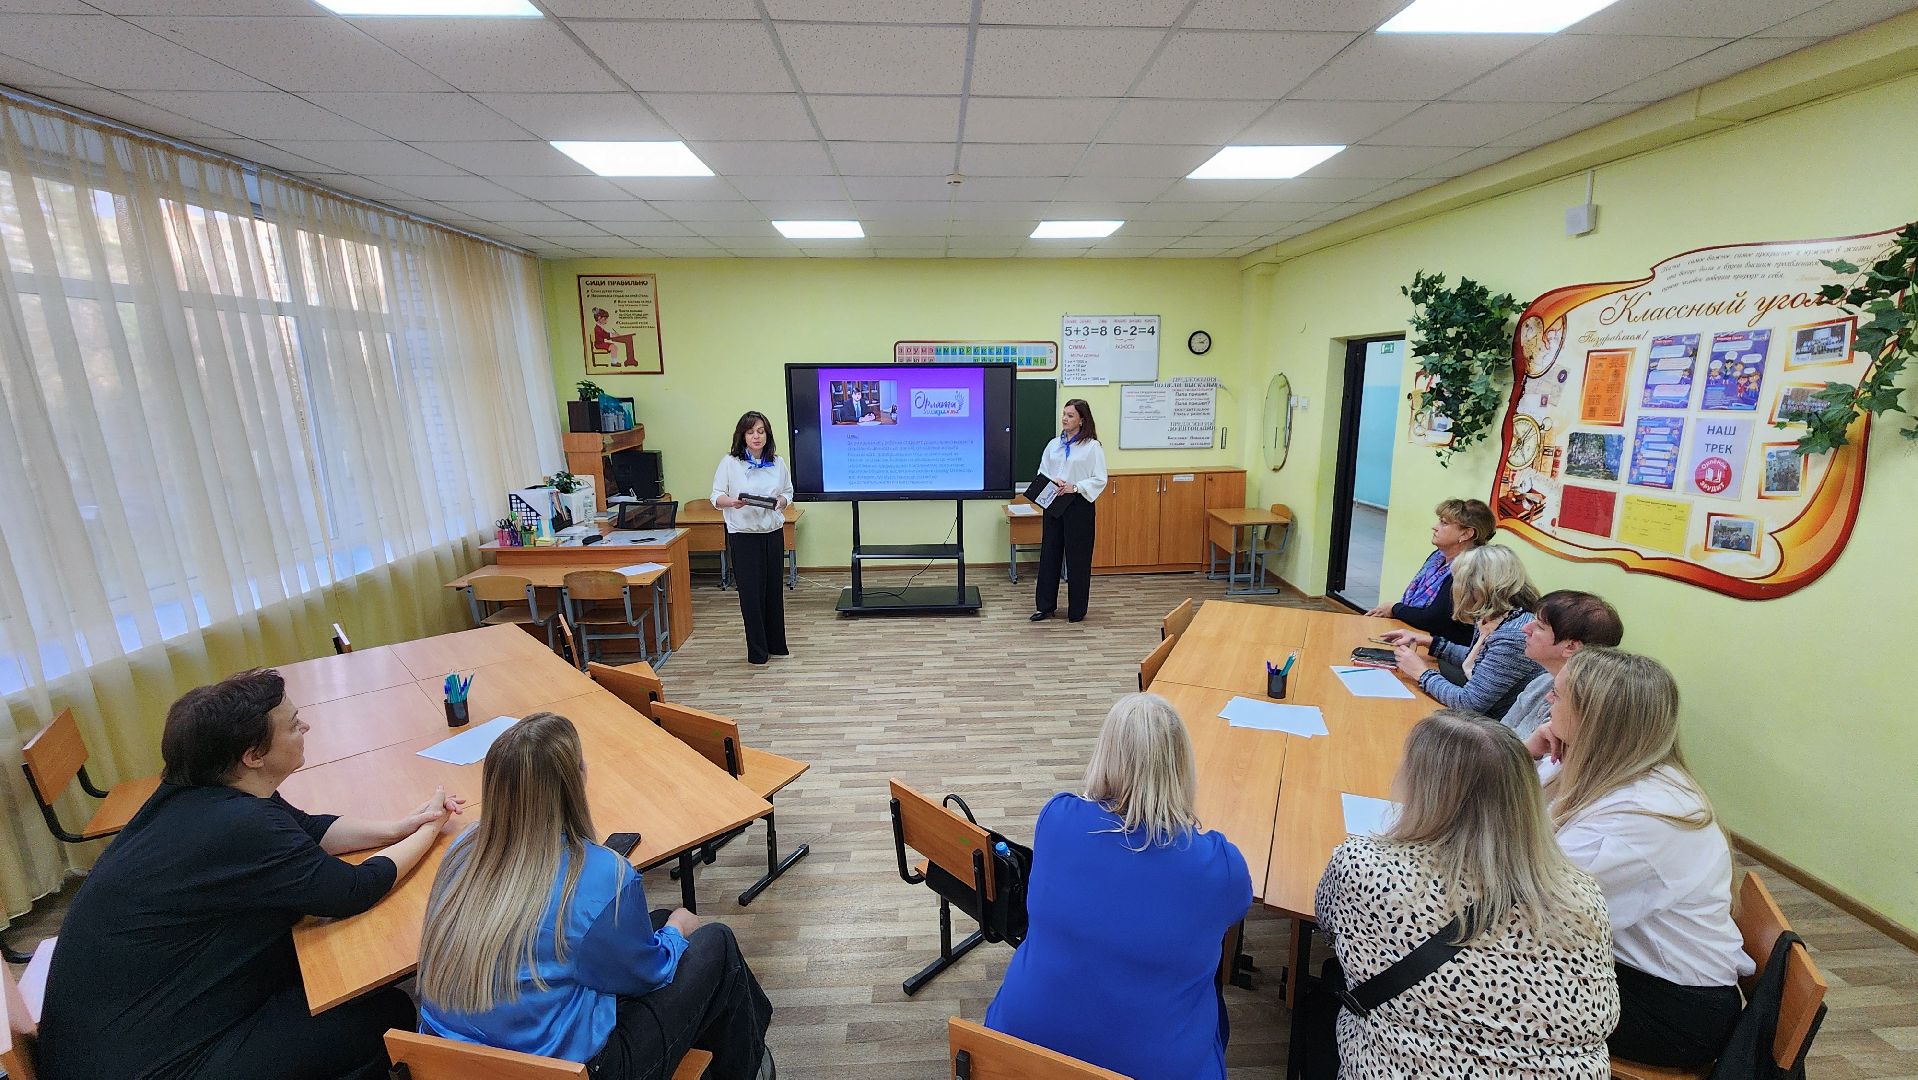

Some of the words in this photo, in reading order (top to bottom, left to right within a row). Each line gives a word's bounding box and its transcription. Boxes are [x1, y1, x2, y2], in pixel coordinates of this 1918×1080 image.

[1599, 291, 1746, 326] Классный
[1748, 292, 1849, 327] угол
[1064, 326, 1108, 336] 5+3=8
[1578, 329, 1648, 346] Поздравляем!
[1706, 425, 1737, 436] НАШ
[1704, 444, 1733, 454] ТРЕК
